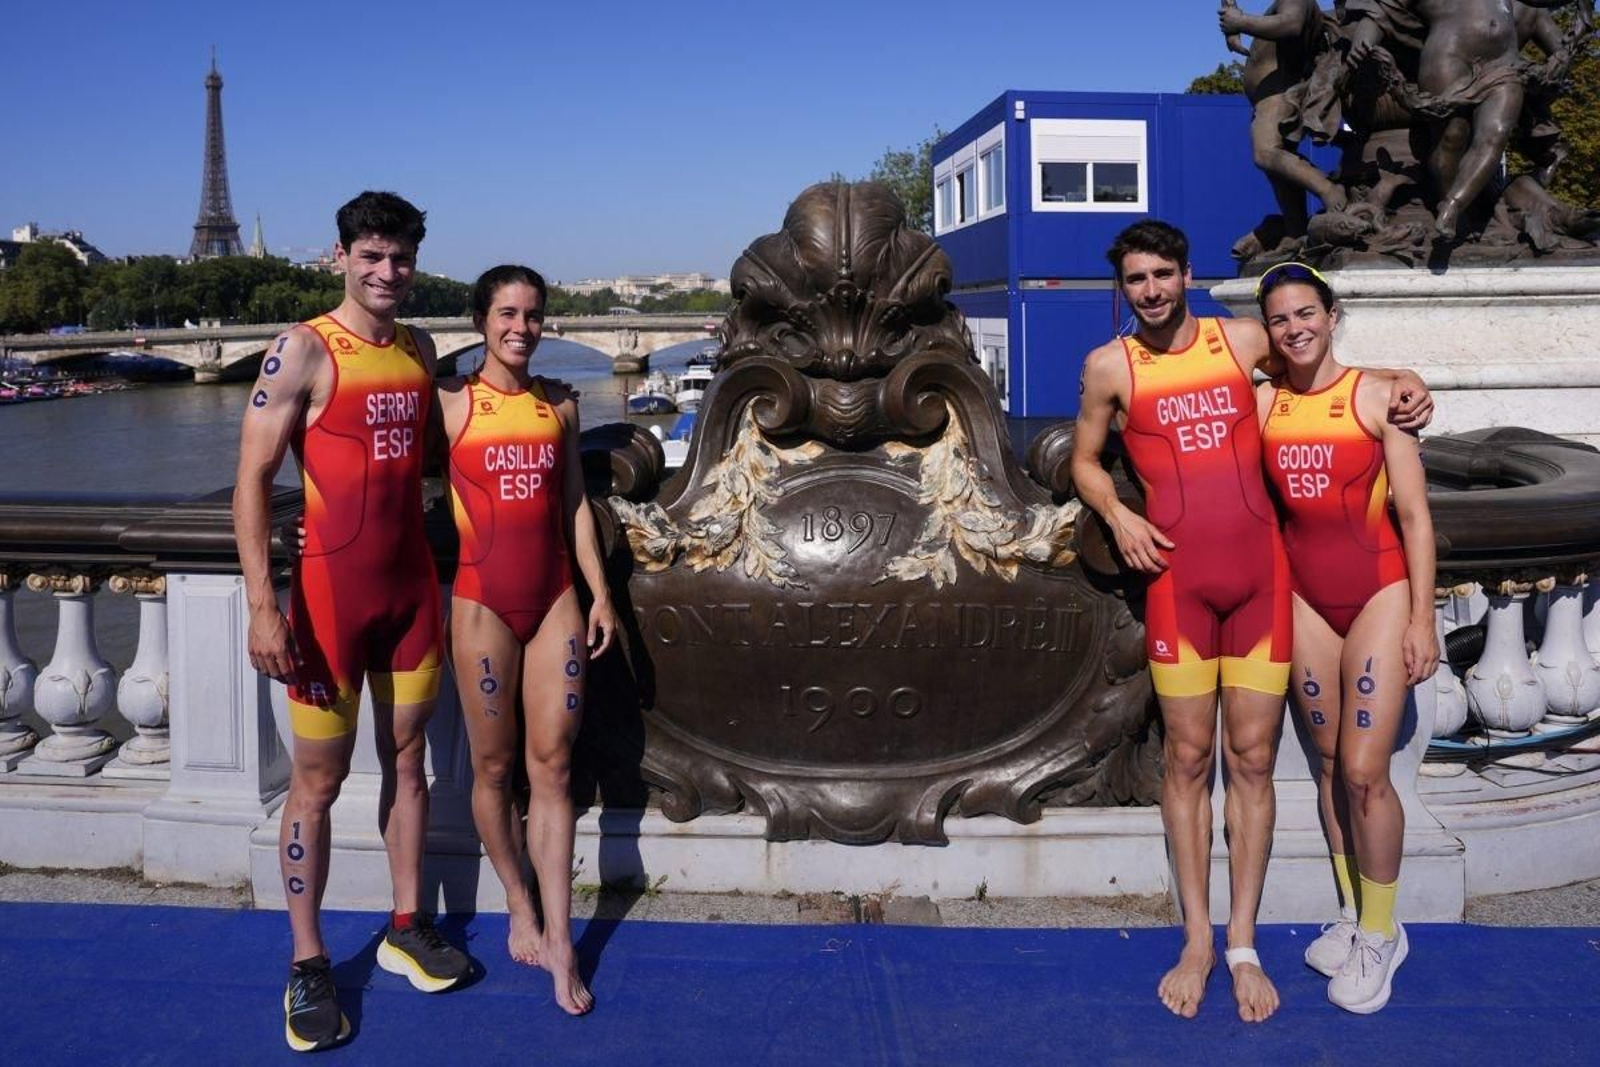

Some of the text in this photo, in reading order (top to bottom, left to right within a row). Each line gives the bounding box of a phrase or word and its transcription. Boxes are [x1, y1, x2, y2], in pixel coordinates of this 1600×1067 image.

[253, 389, 268, 408] C
[366, 391, 420, 425] SERRAT
[1157, 386, 1238, 425] GONZALEZ
[374, 428, 413, 461] ESP
[1176, 421, 1227, 452] ESP
[485, 444, 555, 471] CASILLAS
[1278, 444, 1334, 469] GODOY
[499, 474, 542, 500] ESP
[1287, 473, 1330, 498] ESP
[801, 506, 897, 554] 1897
[566, 693, 578, 710] D
[780, 686, 922, 733] 1900
[1310, 710, 1326, 725] B
[1356, 709, 1371, 728] B
[288, 876, 305, 895] C
